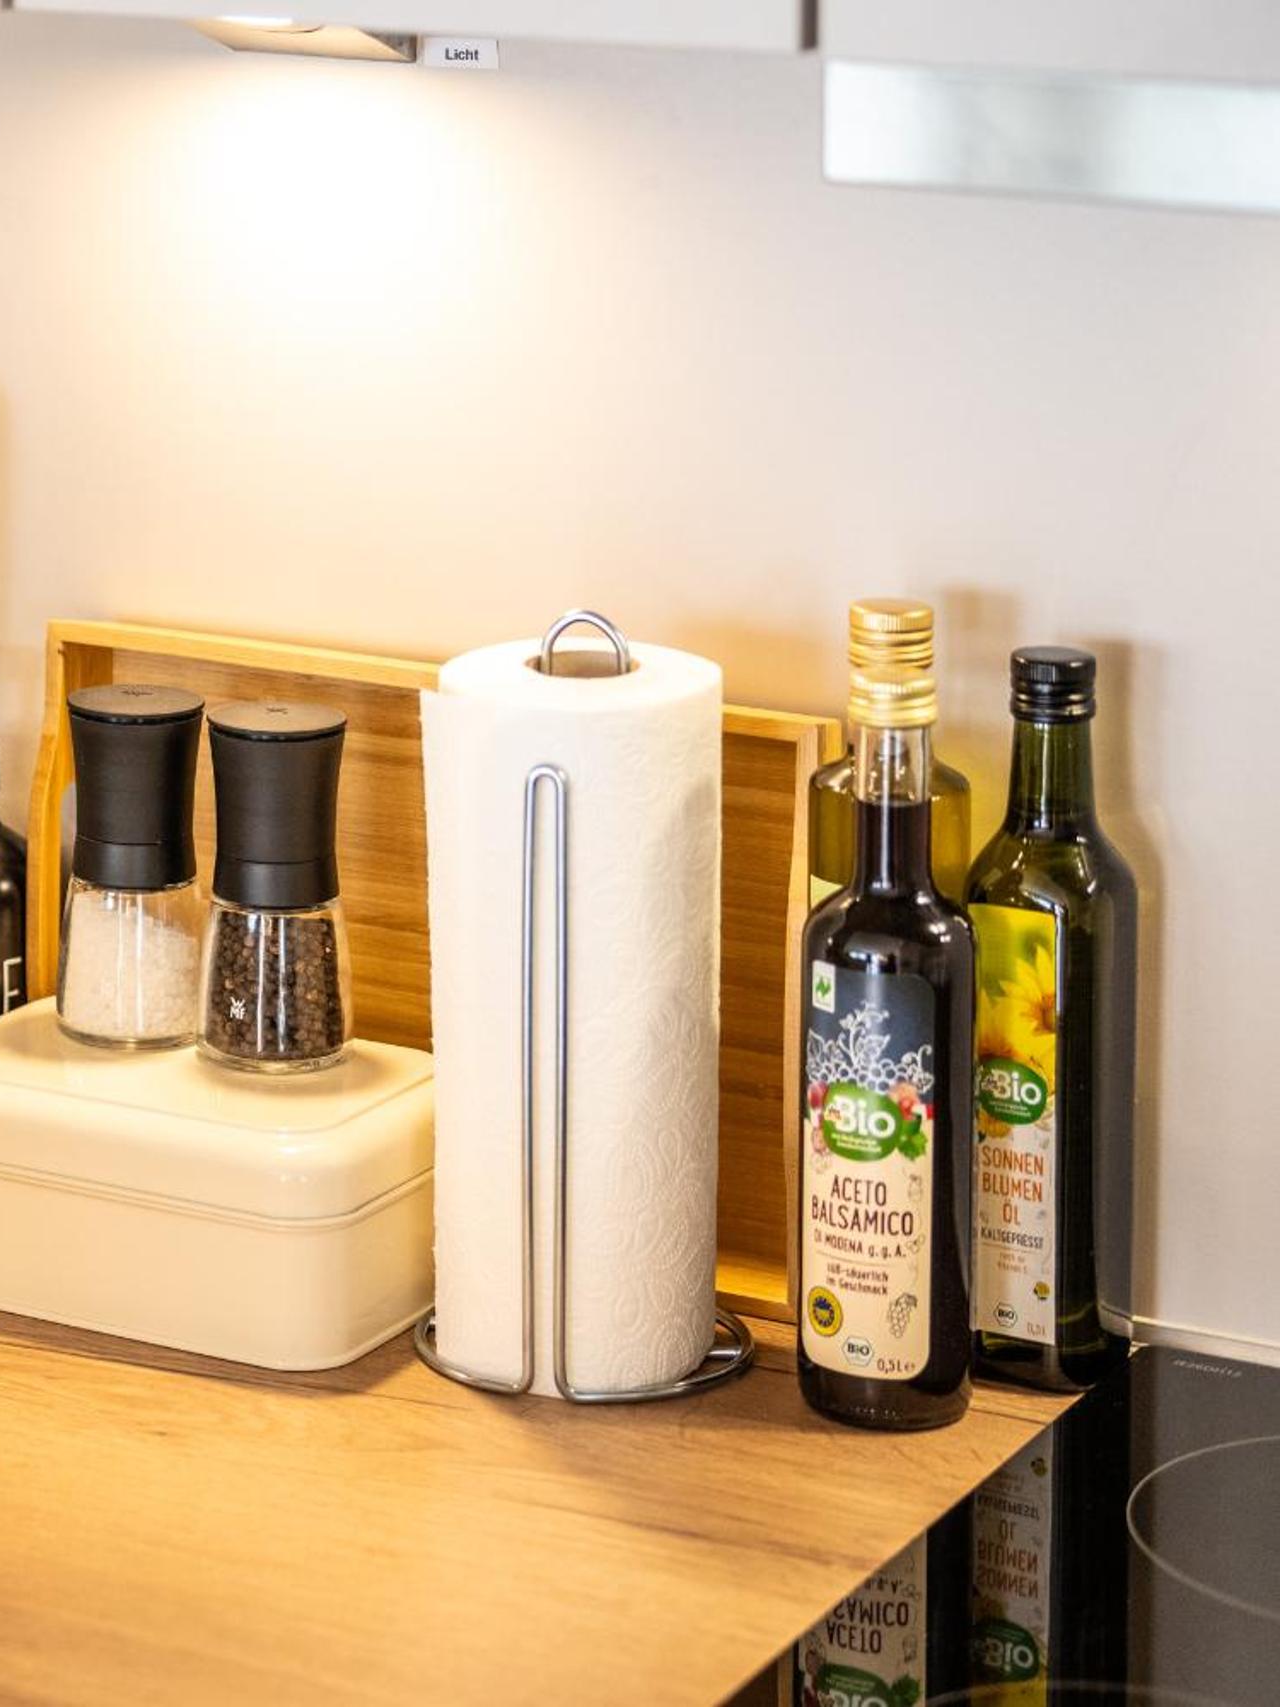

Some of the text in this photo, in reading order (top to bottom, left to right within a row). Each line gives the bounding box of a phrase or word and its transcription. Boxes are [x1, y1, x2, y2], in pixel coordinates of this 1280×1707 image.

[445, 47, 479, 60] Licht
[991, 1068, 1042, 1105] Bio
[833, 1095, 896, 1139] Bio
[982, 1145, 1044, 1176] SONNEN
[831, 1174, 887, 1206] ACETO
[982, 1172, 1042, 1202] BLUMEN
[811, 1194, 914, 1236] BALSAMICO
[1003, 1198, 1020, 1225] ÖL
[825, 1234, 863, 1254] MODENA
